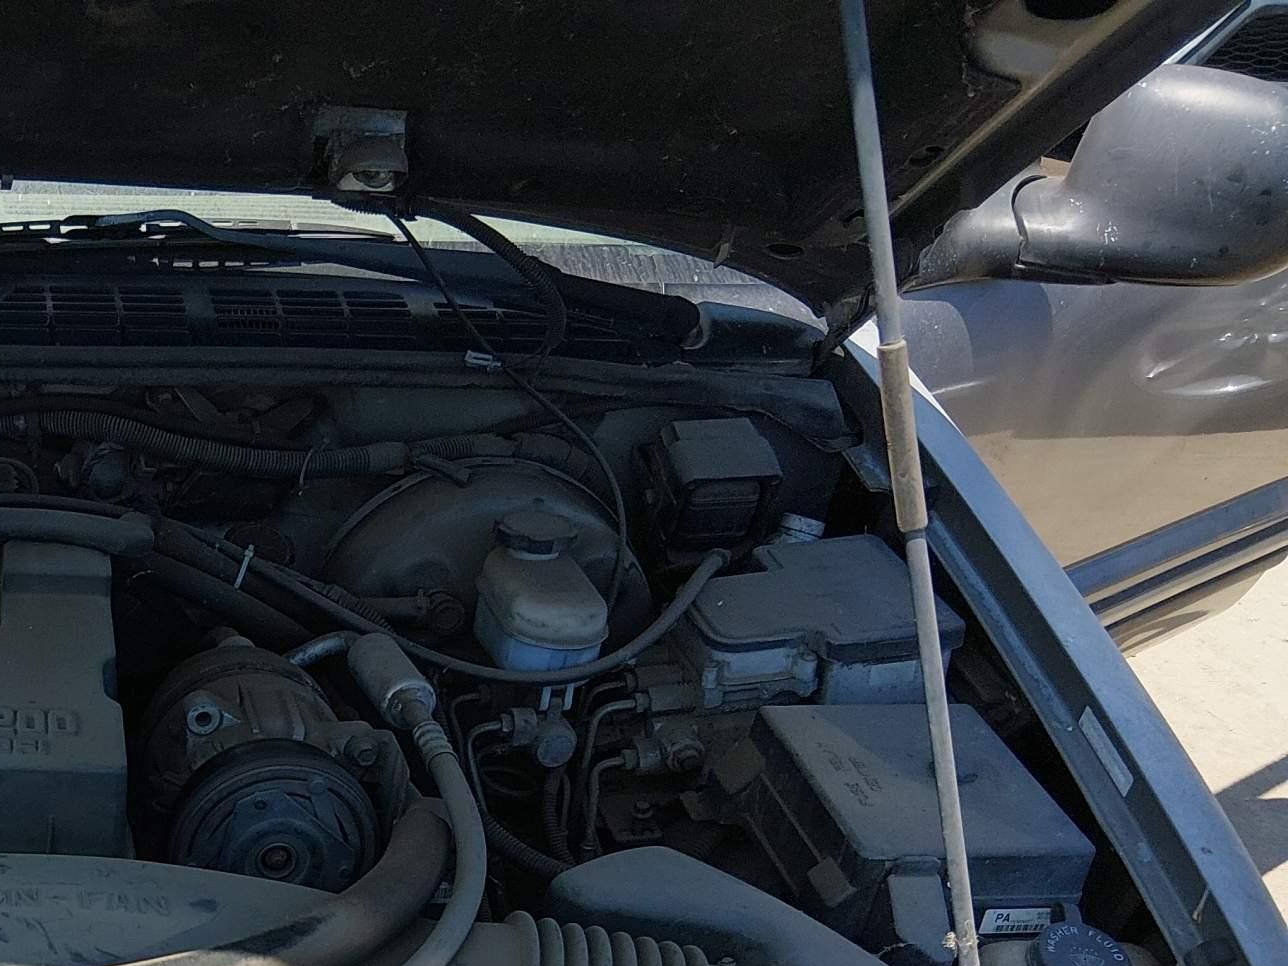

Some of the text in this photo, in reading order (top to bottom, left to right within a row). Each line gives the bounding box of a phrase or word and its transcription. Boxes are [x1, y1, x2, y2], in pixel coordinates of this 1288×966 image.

[77, 887, 171, 916] FAN
[994, 912, 1011, 923] PA
[1047, 925, 1125, 961] WASHER FLUID
